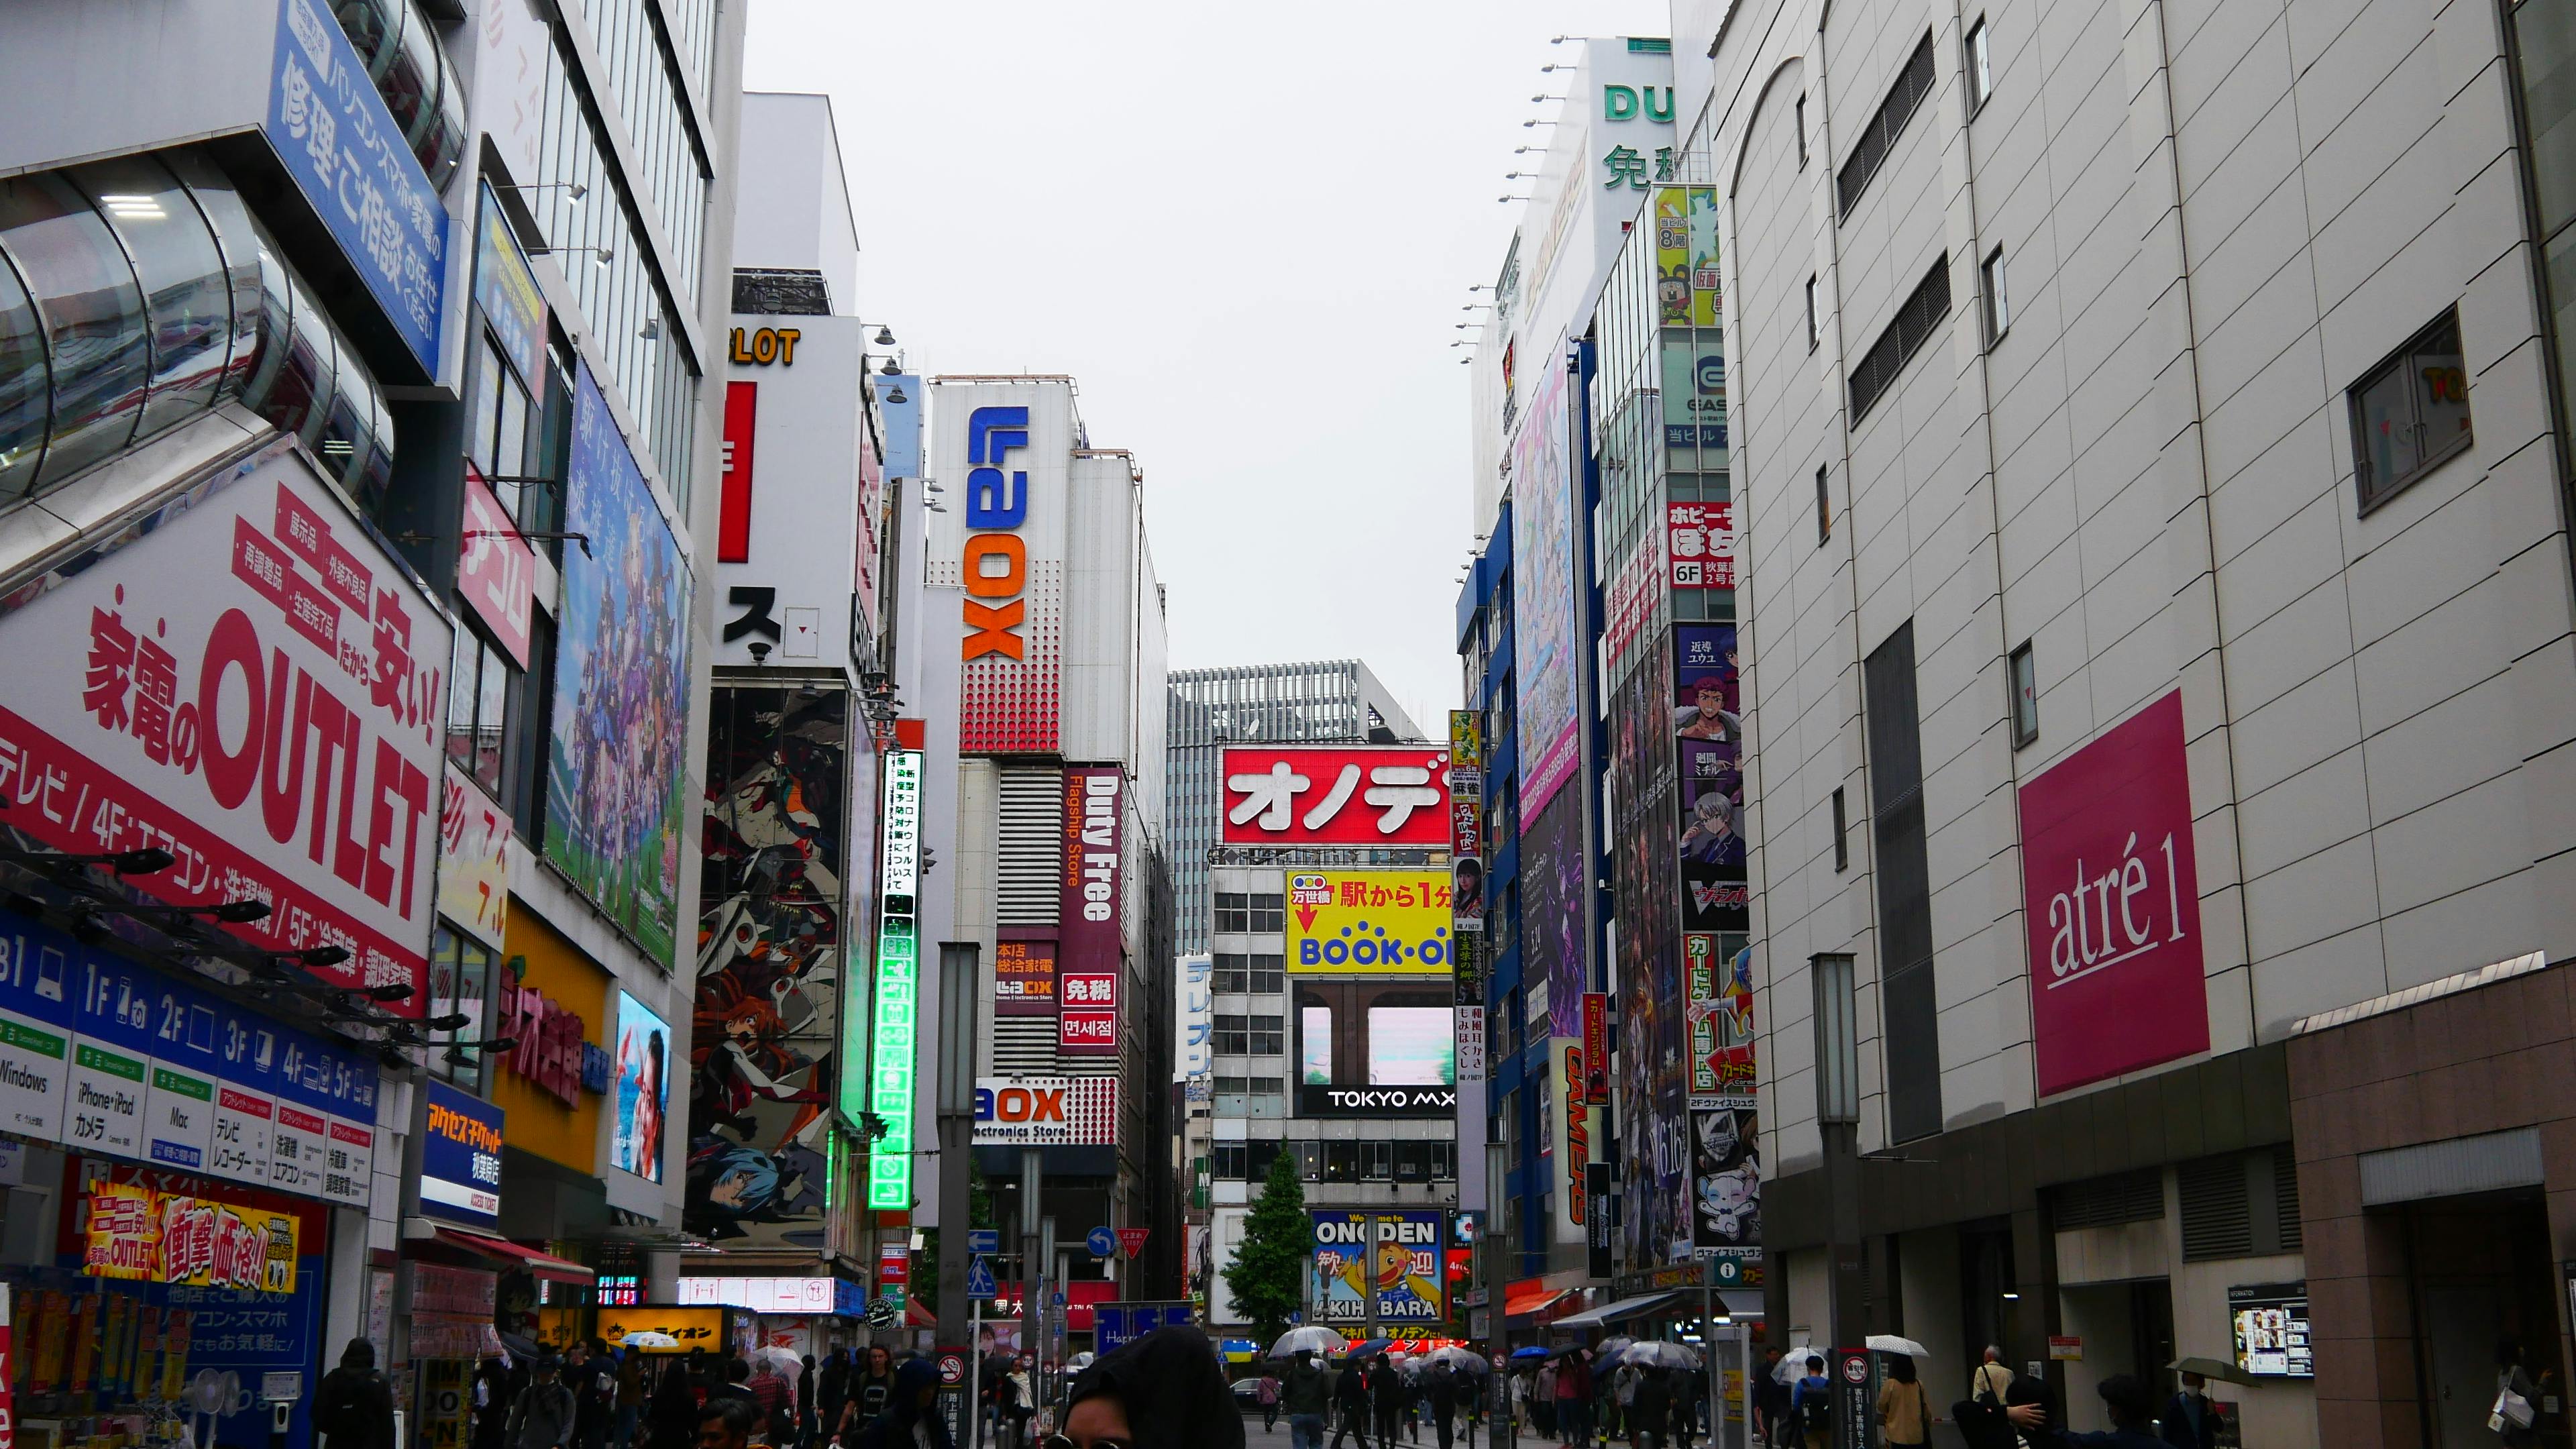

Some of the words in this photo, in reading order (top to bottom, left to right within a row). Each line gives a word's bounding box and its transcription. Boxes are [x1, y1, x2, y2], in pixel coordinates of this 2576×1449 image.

[1660, 219, 1686, 227] 当ビル
[1660, 228, 1686, 248] 8階
[290, 510, 317, 554] 展示品
[244, 540, 282, 592] 再調整品
[329, 553, 366, 604] 外装不良品
[1675, 566, 1700, 582] 6F
[293, 590, 333, 641] 生産完了品
[340, 637, 368, 686] だから
[83, 597, 201, 775] 家電の
[199, 608, 429, 921] OUTLET
[1228, 752, 1450, 834] オノデ
[1453, 782, 1480, 796] 麻雀
[903, 769, 915, 878] 新型コロナウイルス
[1065, 775, 1083, 839] Flagship
[1081, 775, 1119, 847] Duty
[1067, 845, 1082, 888] Store
[1082, 852, 1118, 922] Free
[1291, 890, 1331, 906] 万世橋
[2049, 830, 2151, 978] atré
[2160, 831, 2186, 943] 1
[996, 943, 1026, 958] 本店
[996, 959, 1054, 974] 総合家電
[86, 962, 111, 1016] 1F
[1066, 979, 1112, 1001] 免税
[158, 994, 184, 1042] 2F
[1064, 1020, 1113, 1038] 면세점
[1688, 935, 1715, 1091] カードゲム専門店
[225, 1020, 247, 1064] 3F
[283, 1042, 304, 1084] 4F
[334, 1062, 352, 1101] 5F
[1328, 1091, 1407, 1107] TOKYO
[1413, 1091, 1455, 1107] MX
[1690, 1099, 1758, 1107] 2Fヴァイスシュヴ
[75, 1112, 105, 1140] カメラ
[170, 1106, 189, 1130] Mac
[217, 1118, 240, 1144] テレビ
[427, 1104, 502, 1155] アクセスチケット
[1032, 1125, 1067, 1137] Store
[213, 1146, 252, 1172] レコーダー
[273, 1161, 300, 1184] エアコン
[472, 1151, 500, 1185] 秋葉原店
[484, 1196, 496, 1212] TICKET
[1348, 1214, 1392, 1223] Weme
[1393, 1214, 1404, 1223] to
[111, 1238, 153, 1270] OUTLET
[164, 1196, 270, 1291] 衝撃価格!!
[1410, 1252, 1434, 1275] 迎
[1315, 1299, 1436, 1317] AKIHBARA
